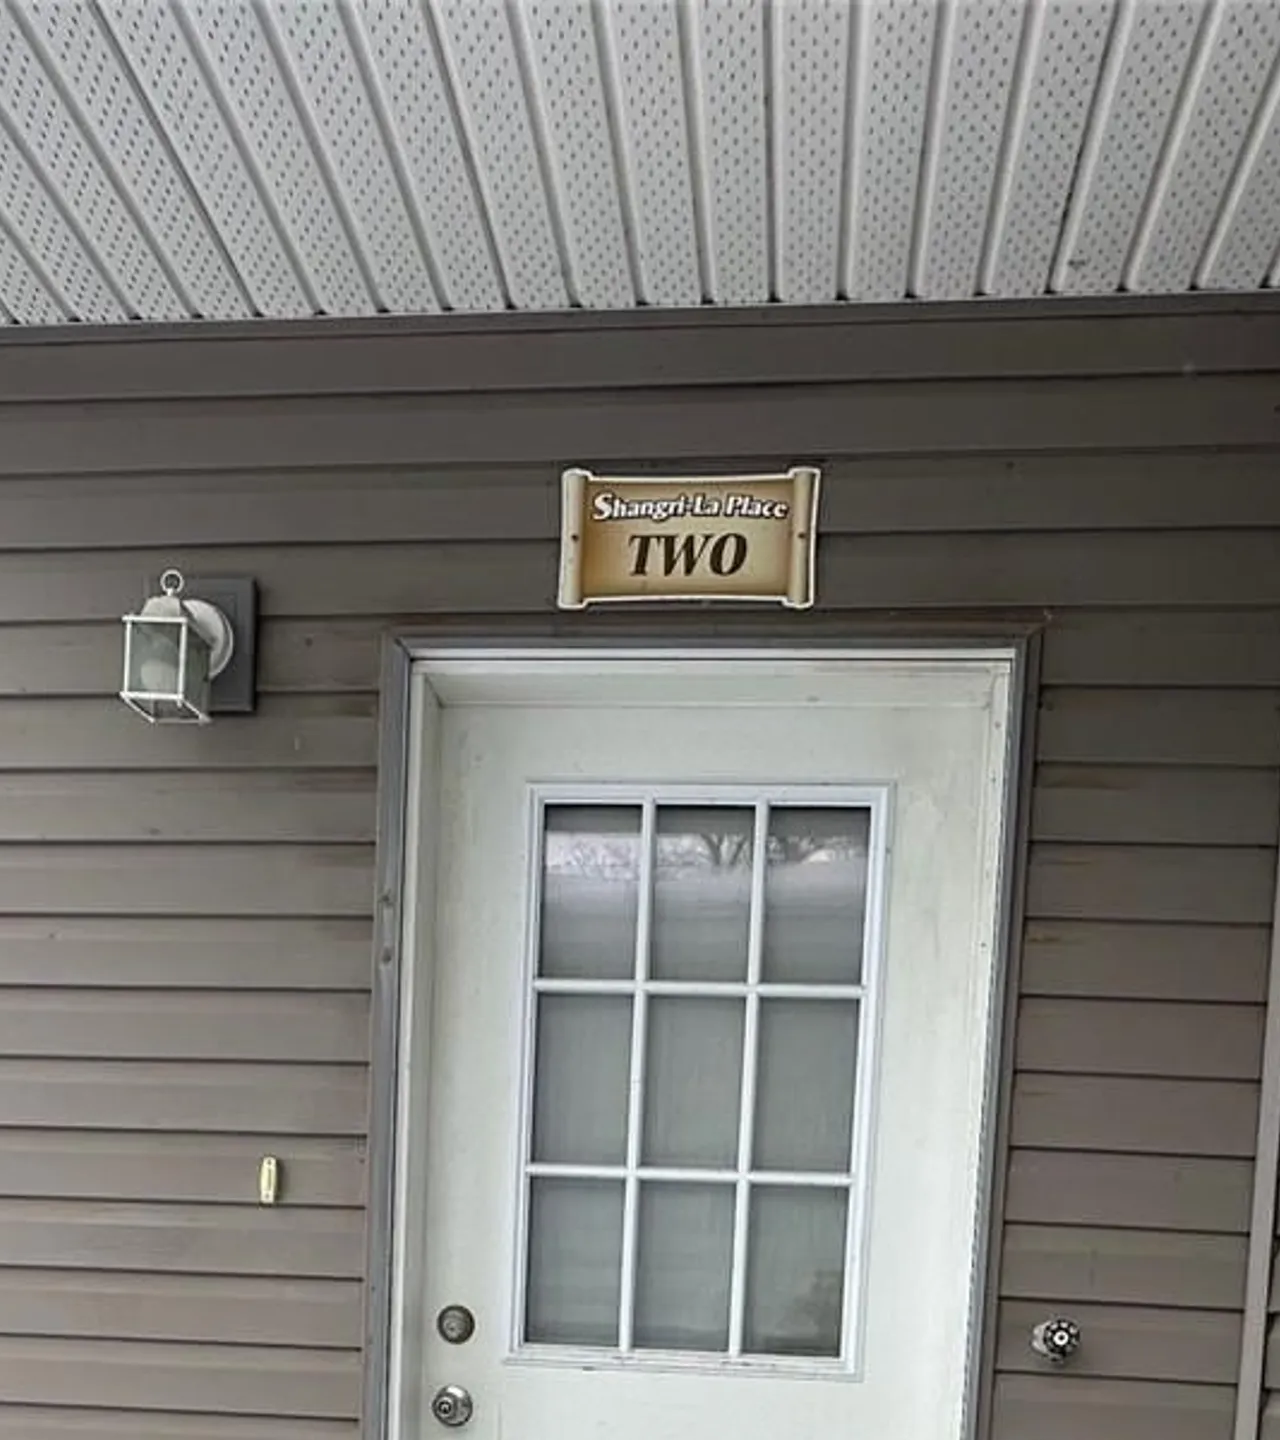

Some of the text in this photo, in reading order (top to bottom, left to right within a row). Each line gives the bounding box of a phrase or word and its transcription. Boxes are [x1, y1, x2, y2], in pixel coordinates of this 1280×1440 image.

[592, 491, 789, 521] Shangri-La Place
[628, 532, 748, 577] TWO
